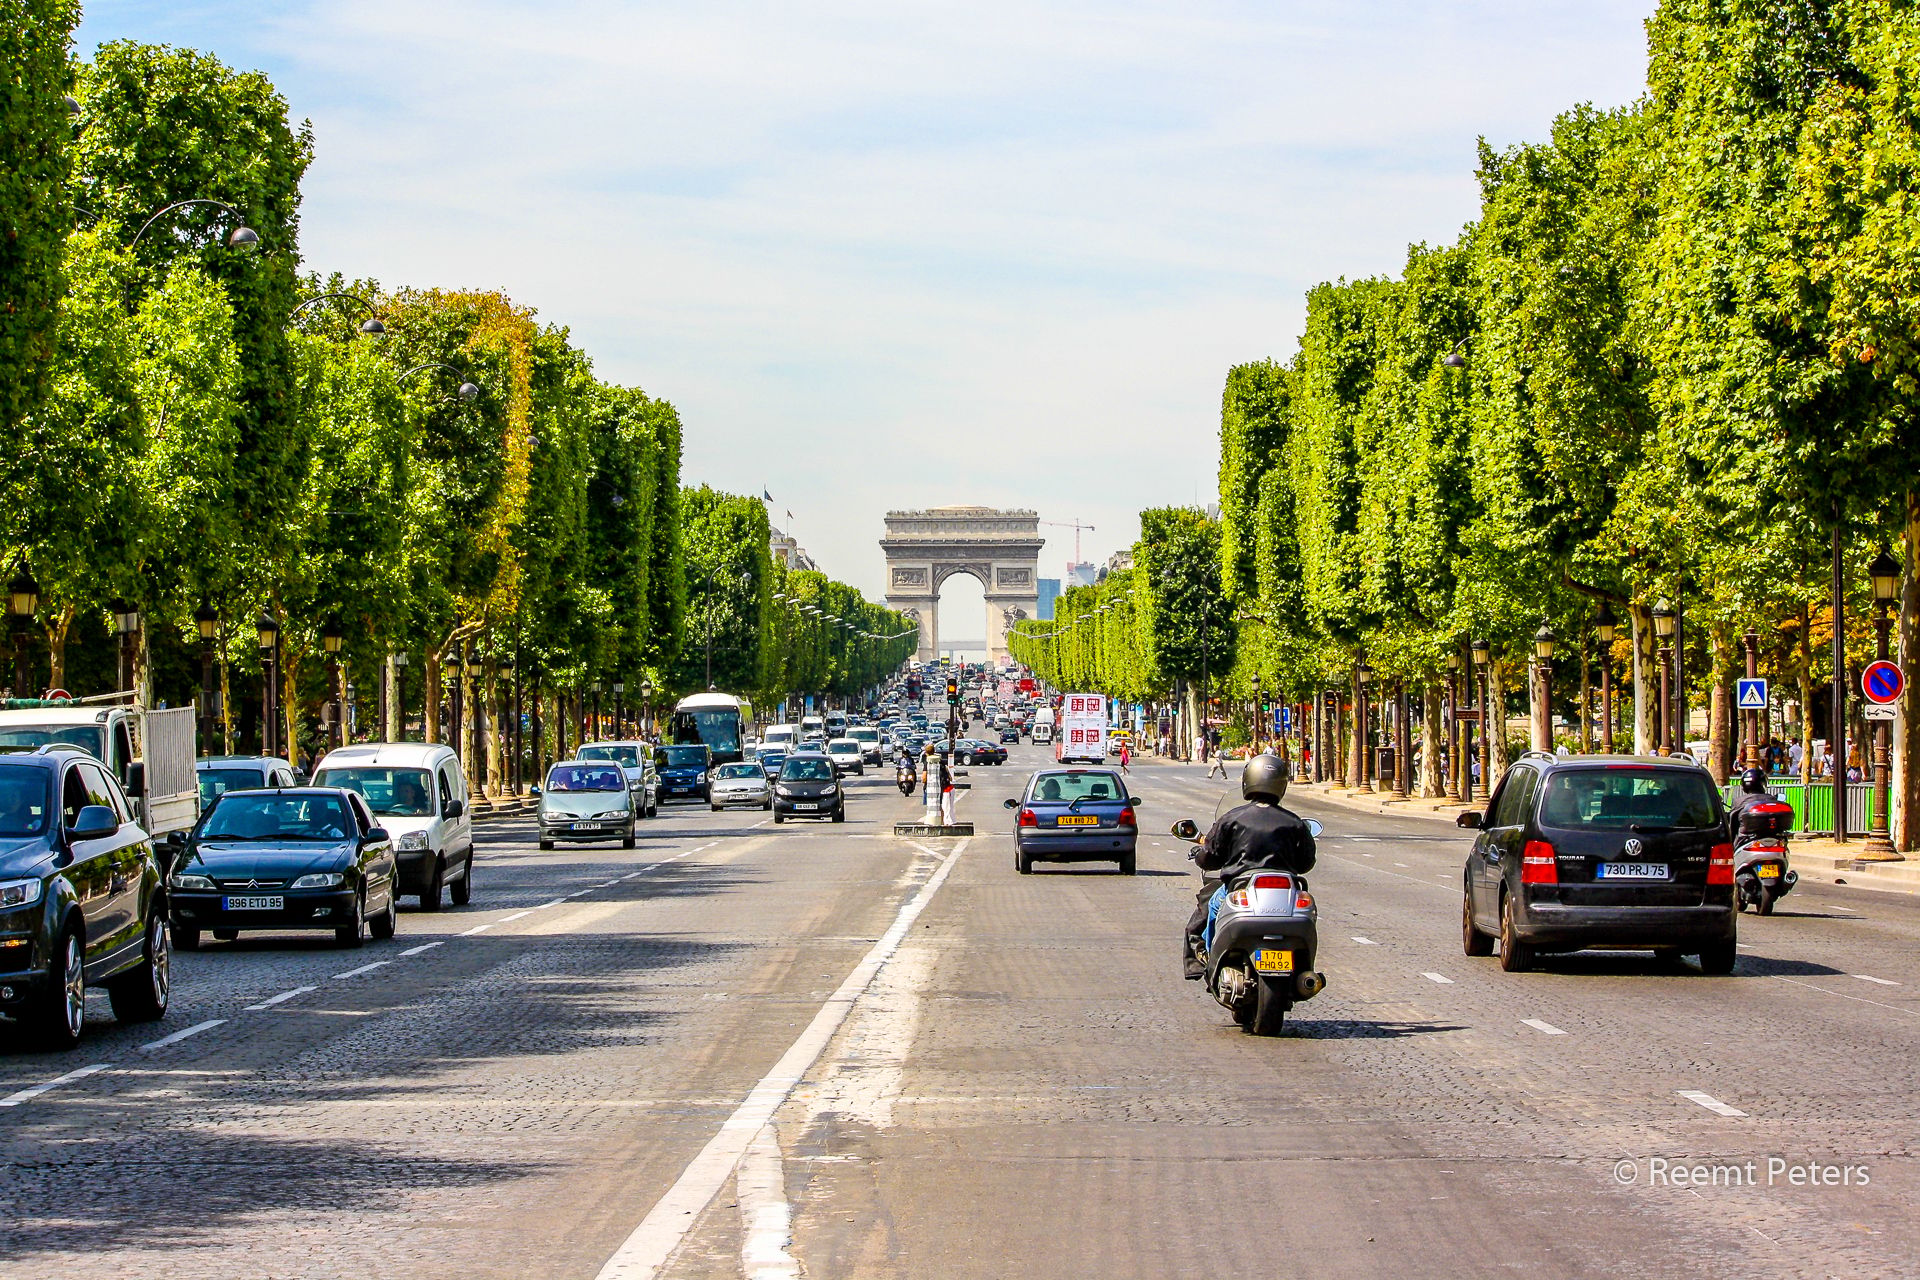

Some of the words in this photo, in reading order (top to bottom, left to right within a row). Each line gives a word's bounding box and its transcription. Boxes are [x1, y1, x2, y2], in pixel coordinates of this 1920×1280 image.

[1605, 864, 1626, 875] 730
[1629, 865, 1649, 875] PRJ
[1651, 865, 1665, 876] 75
[229, 898, 247, 908] 996
[249, 898, 267, 907] ETD
[269, 897, 282, 907] 95
[1265, 952, 1283, 960] 170
[1277, 961, 1290, 969] 92
